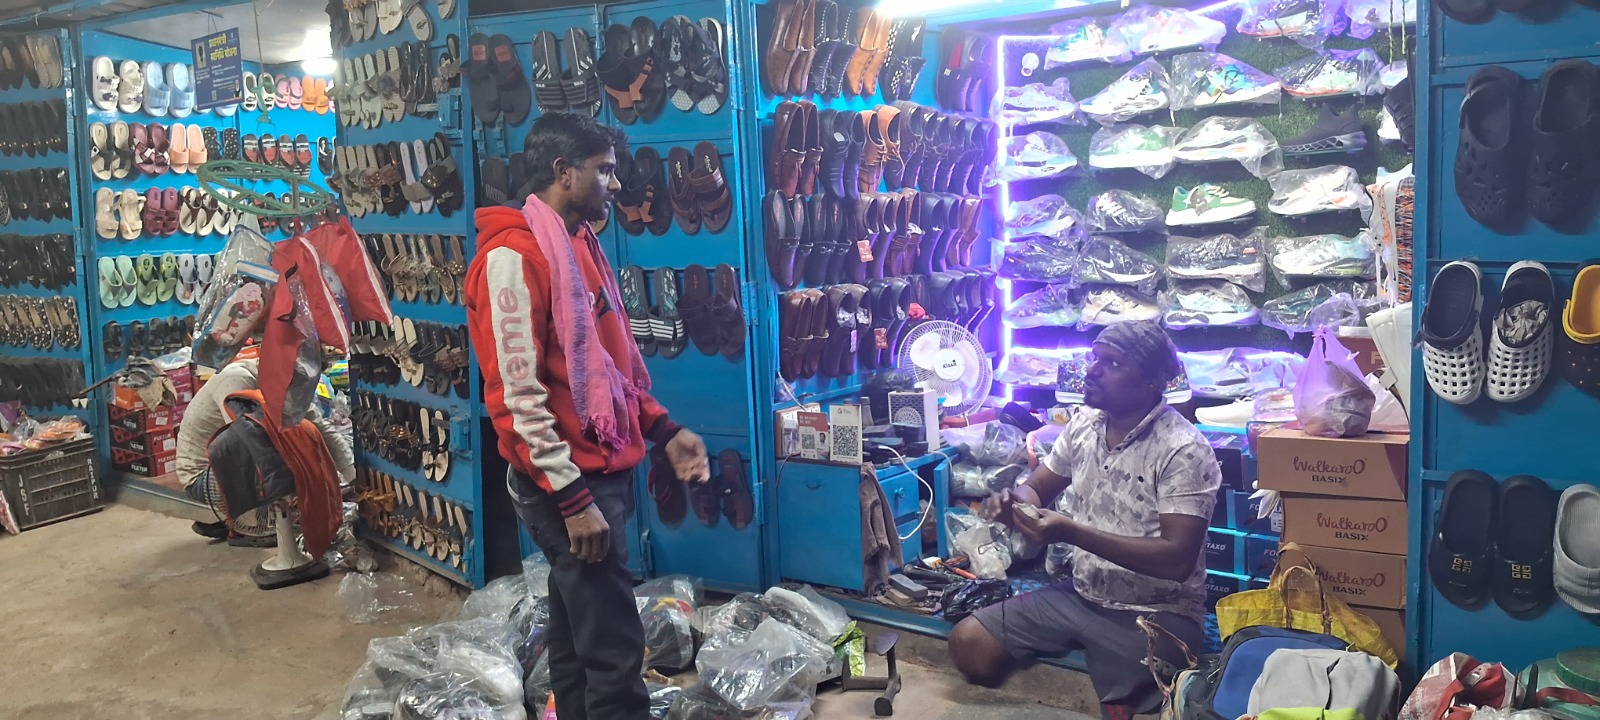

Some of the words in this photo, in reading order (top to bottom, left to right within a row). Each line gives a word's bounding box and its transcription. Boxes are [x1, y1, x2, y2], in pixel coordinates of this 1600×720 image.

[148, 410, 169, 419] FLETER
[123, 419, 137, 429] FLETER
[153, 433, 171, 442] FLETER
[130, 442, 144, 450] FLETER
[158, 455, 175, 463] FLETER
[131, 463, 148, 472] FLETER
[87, 458, 99, 499] RAIPUR
[1312, 475, 1347, 483] BASIX
[1335, 531, 1369, 541] BASIX
[1206, 542, 1226, 551] TAXO
[1205, 584, 1230, 593] OTAXO
[1332, 585, 1367, 596] BASIX
